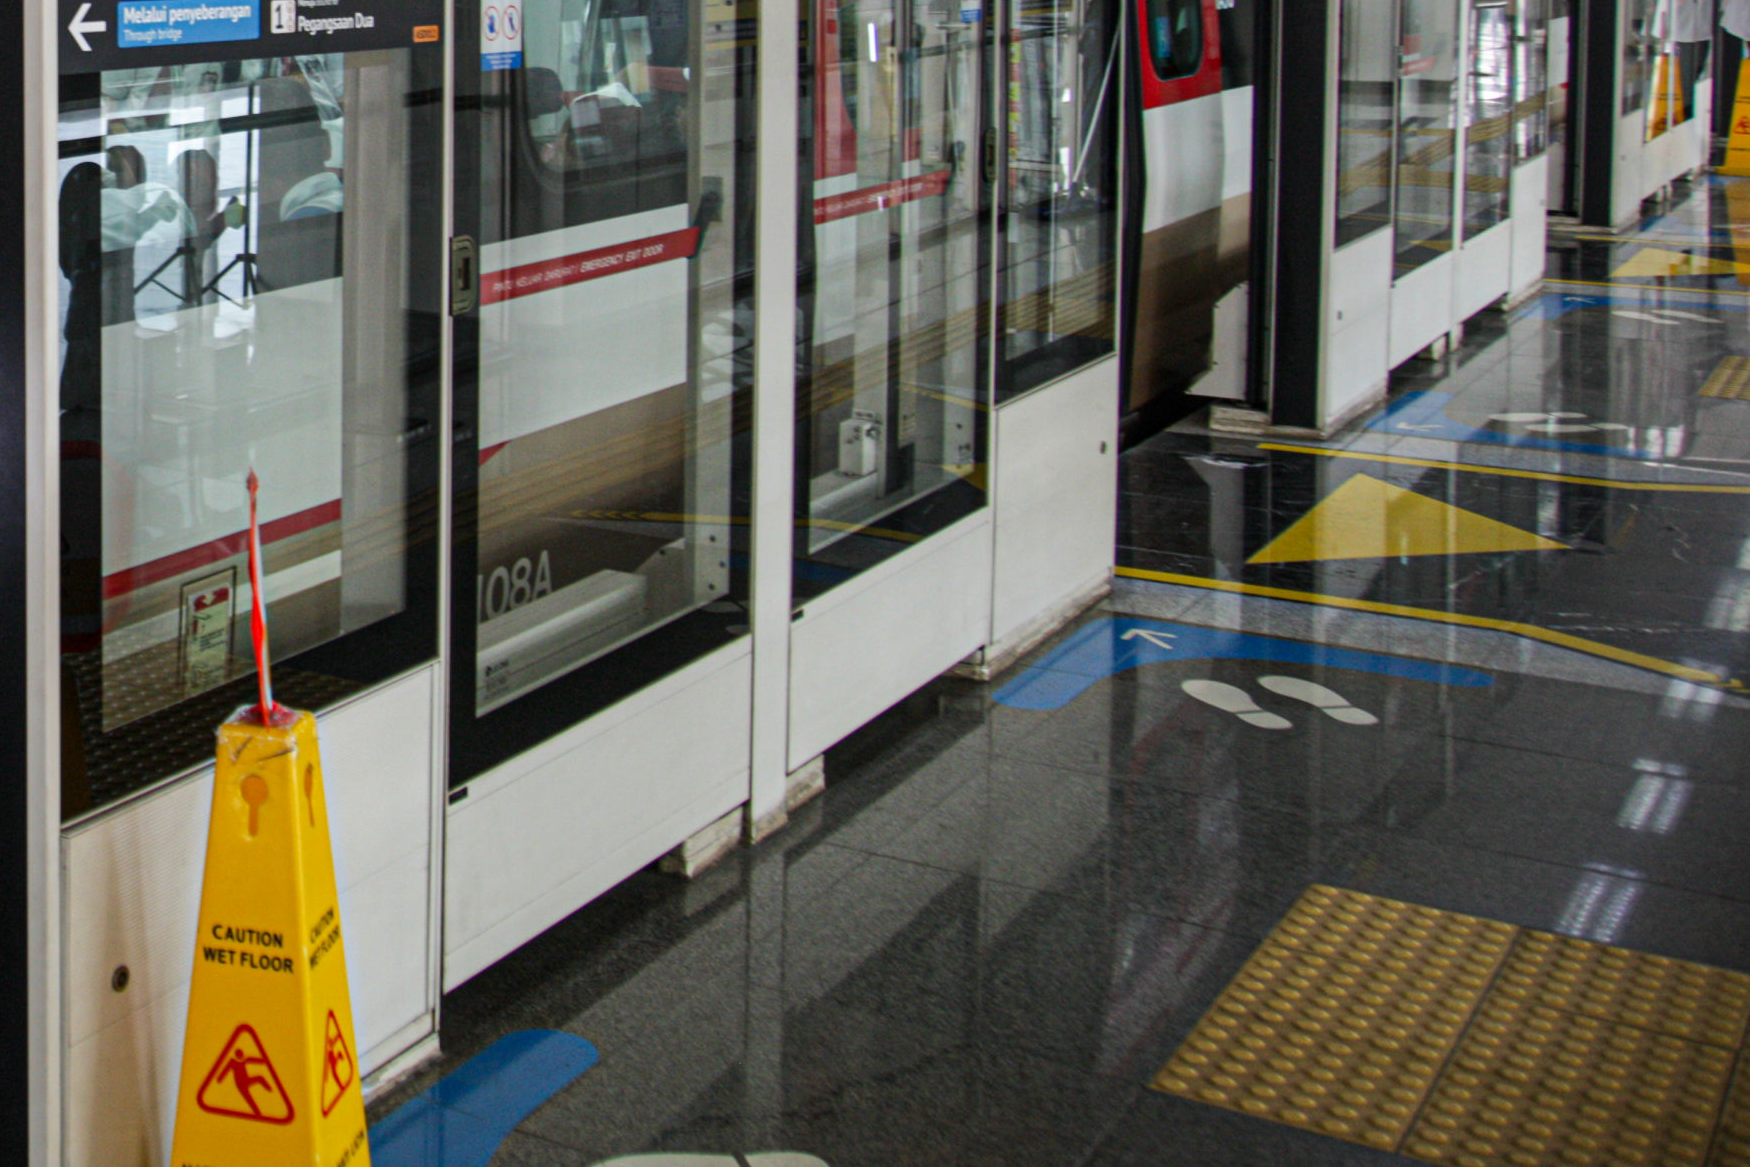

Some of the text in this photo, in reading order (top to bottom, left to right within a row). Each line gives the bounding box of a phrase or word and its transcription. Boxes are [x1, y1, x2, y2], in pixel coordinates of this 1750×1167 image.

[123, 3, 251, 24] Melalui penyeberangan
[275, 5, 284, 29] 1
[298, 12, 375, 35] Pegangsaan Dua
[123, 28, 182, 42] Through bridge
[580, 255, 624, 273] EMERGENCY
[625, 249, 641, 262] EXIT
[643, 244, 664, 258] DOOR
[212, 924, 283, 948] CAUTION
[203, 946, 294, 974] WET FLOOR
